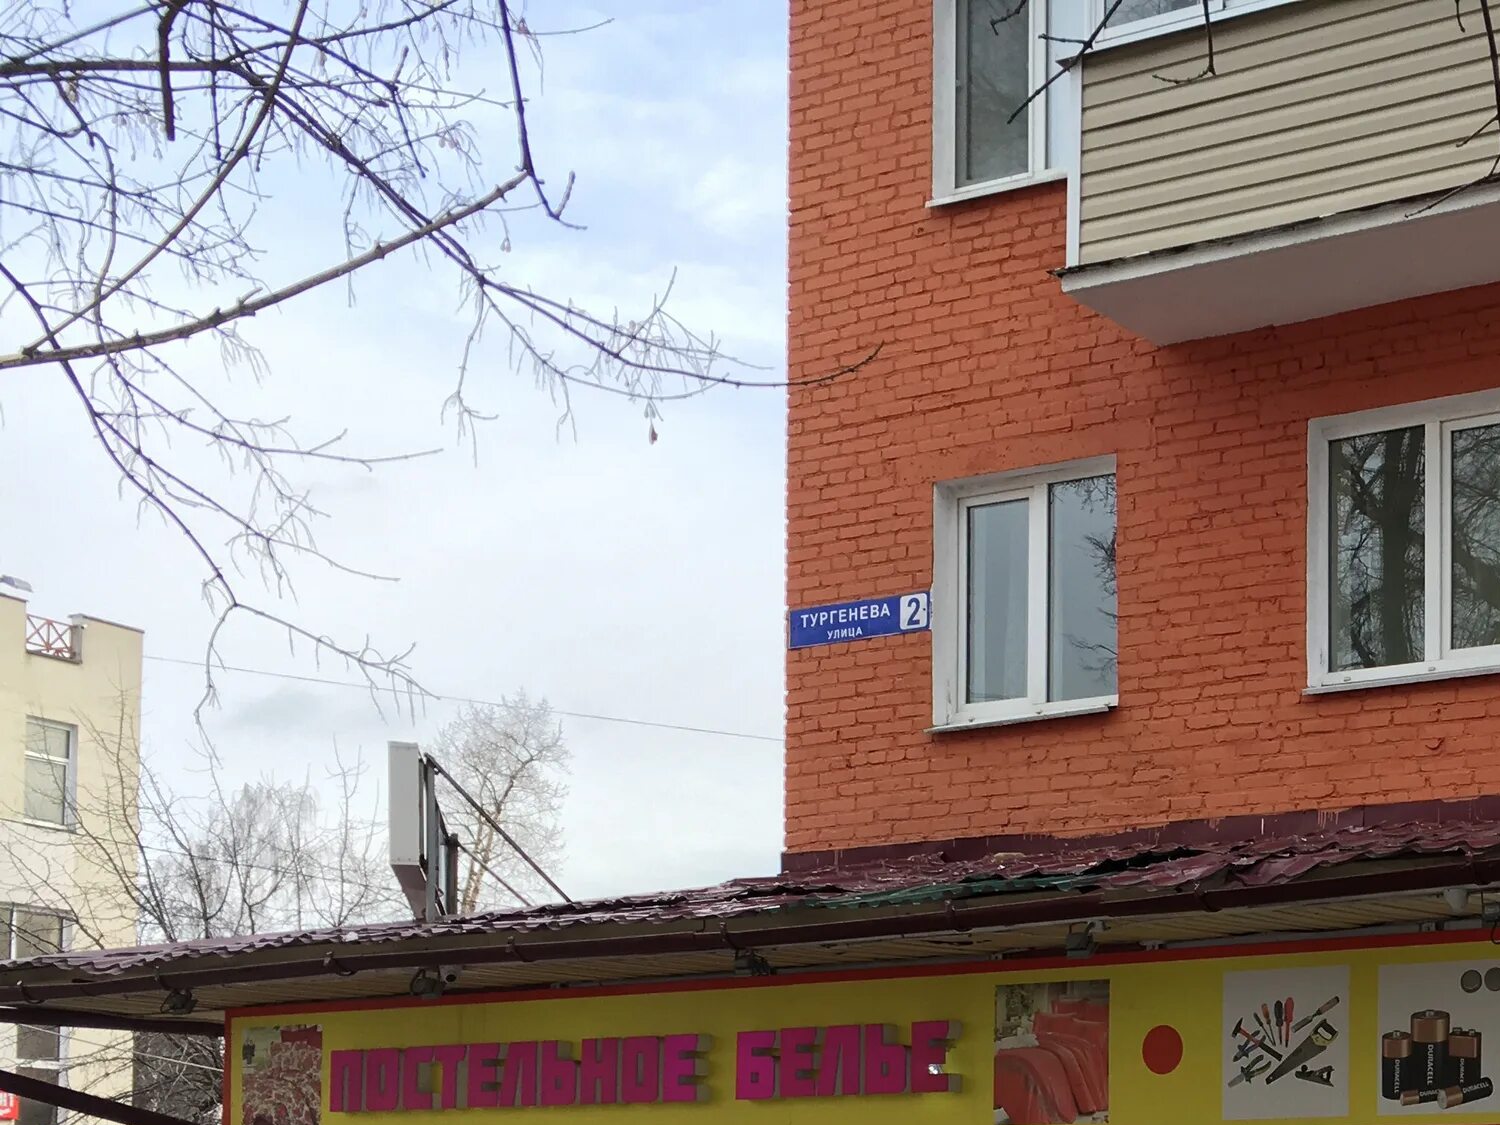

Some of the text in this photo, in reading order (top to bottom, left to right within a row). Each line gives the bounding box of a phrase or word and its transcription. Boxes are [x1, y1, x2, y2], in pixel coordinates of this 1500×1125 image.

[800, 597, 921, 628] ТУРГЕНЕВА 2
[827, 626, 863, 640] УЛИЦА
[330, 1019, 956, 1113] ПОСТЕЛЬНОЕ БЕЛЬЕ
